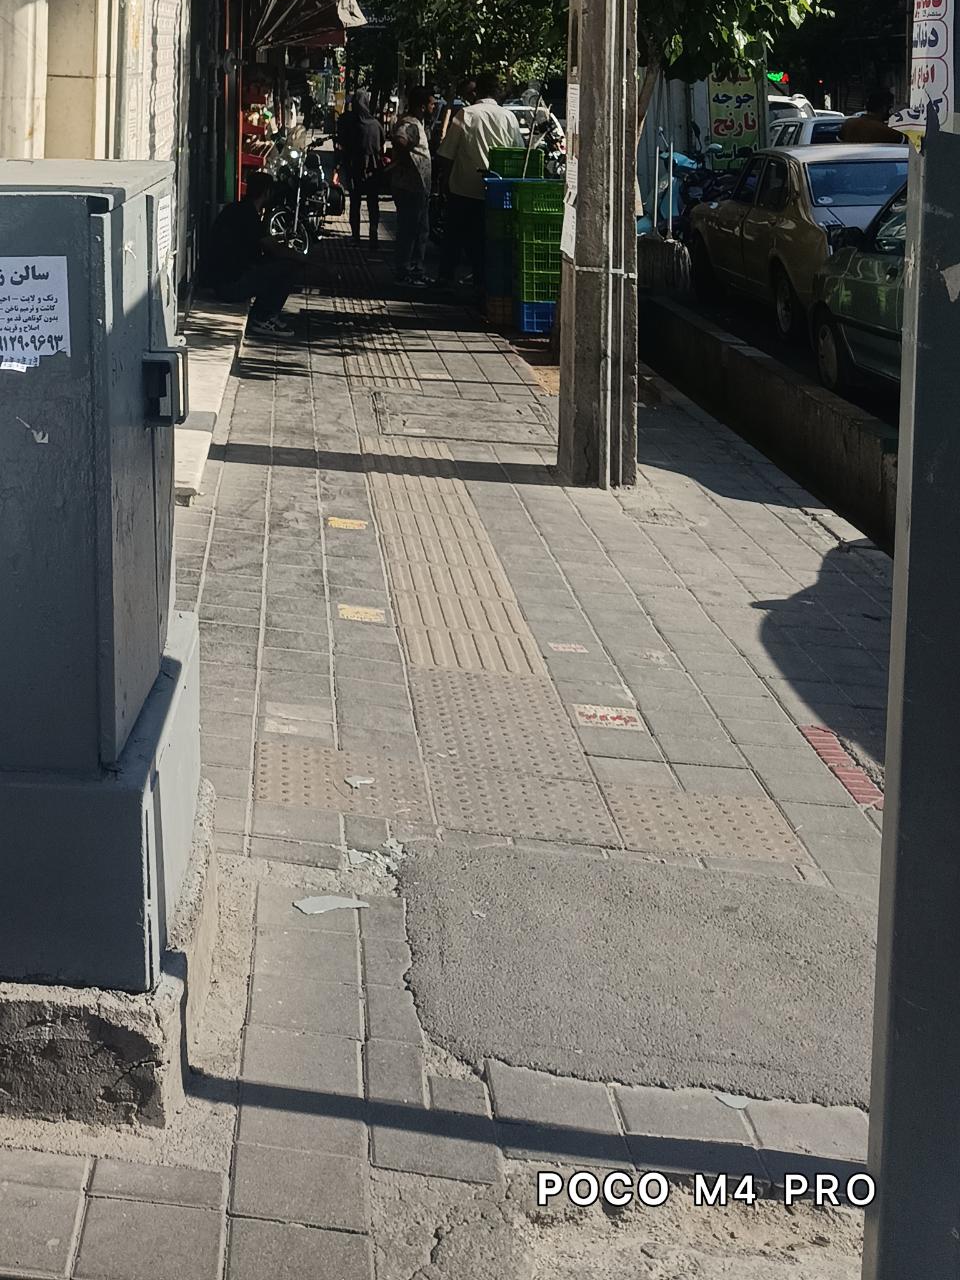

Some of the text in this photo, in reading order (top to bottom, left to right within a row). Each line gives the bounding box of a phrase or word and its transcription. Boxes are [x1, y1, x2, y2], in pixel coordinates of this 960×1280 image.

[712, 92, 755, 110] جوجه
[713, 111, 757, 137] نارنج
[10, 265, 50, 286] سالن
[20, 294, 36, 304] لایت
[42, 294, 58, 304] رنگ
[4, 305, 20, 314] ناخن
[19, 304, 35, 314] ترمیم
[39, 304, 56, 312] کاشت
[22, 315, 43, 324] کوتاهی
[43, 315, 58, 323] بدون
[23, 325, 40, 333] اصلاح
